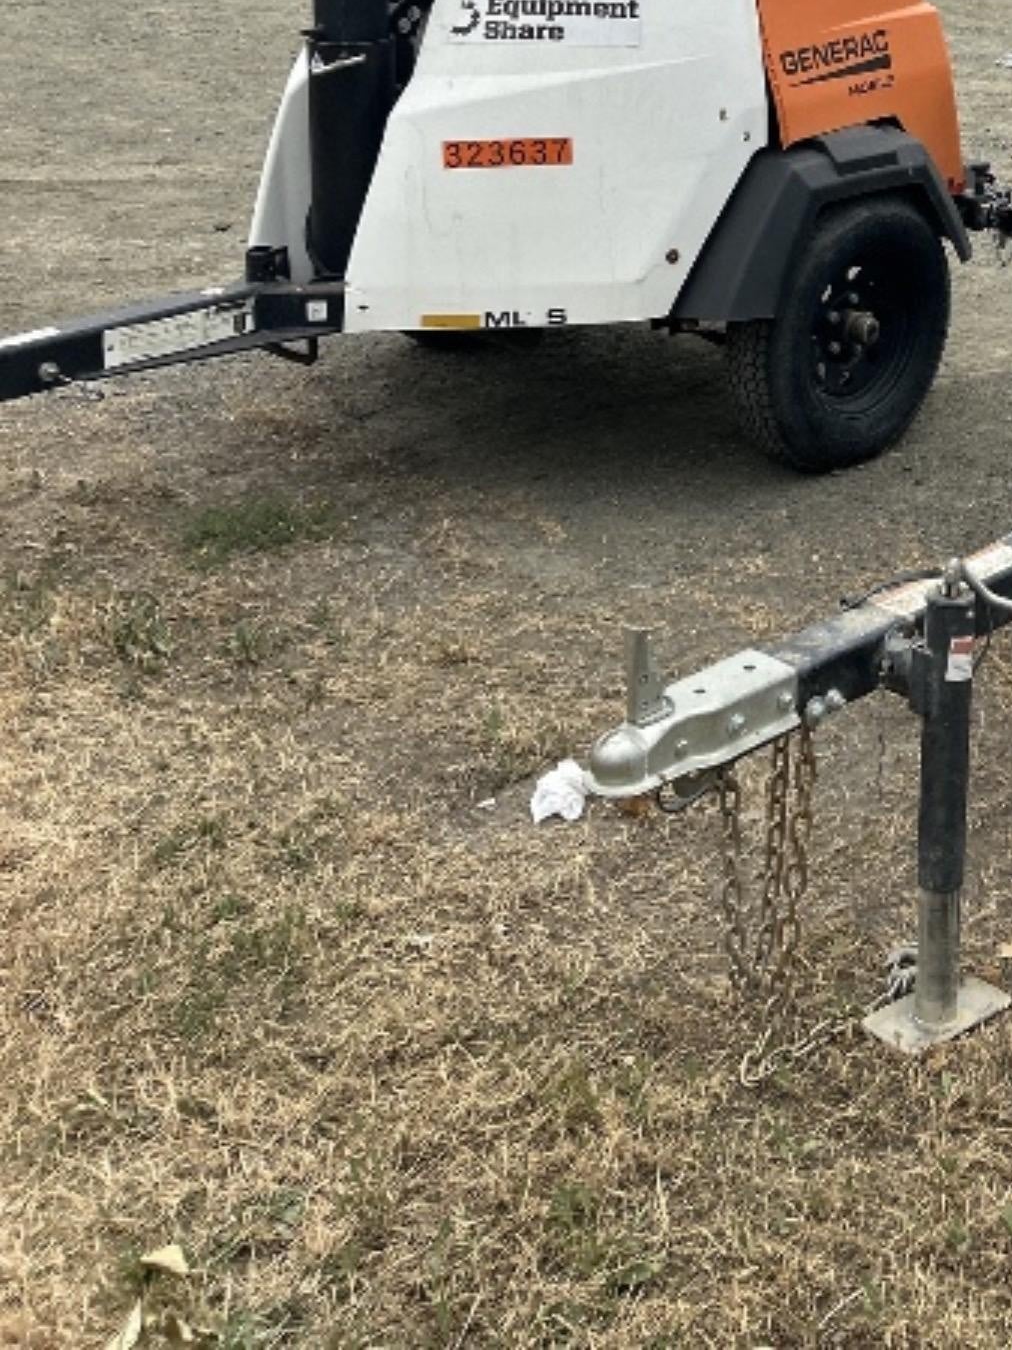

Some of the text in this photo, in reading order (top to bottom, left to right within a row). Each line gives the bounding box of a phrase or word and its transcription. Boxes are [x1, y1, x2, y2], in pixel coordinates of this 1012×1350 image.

[483, 20, 565, 41] Share
[780, 29, 889, 75] GENERAC
[445, 139, 568, 168] 323637
